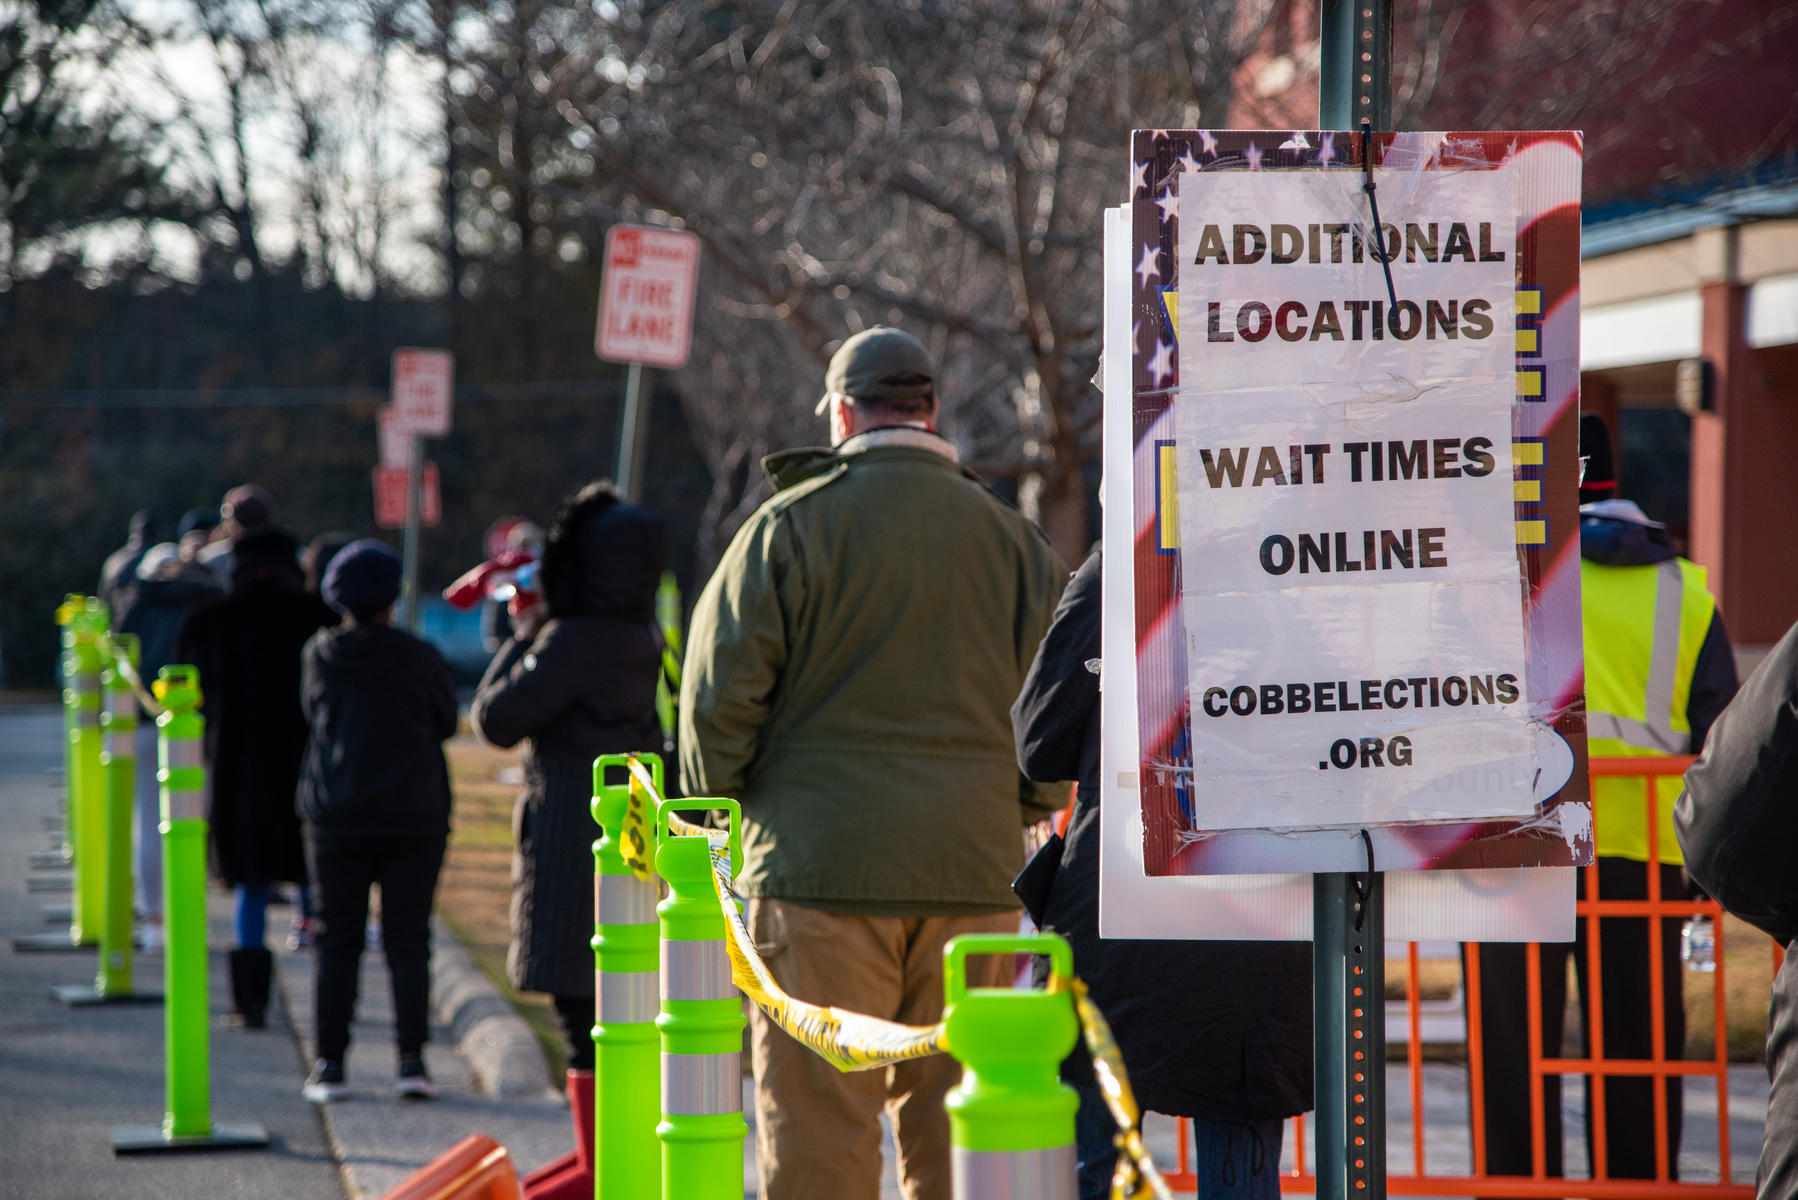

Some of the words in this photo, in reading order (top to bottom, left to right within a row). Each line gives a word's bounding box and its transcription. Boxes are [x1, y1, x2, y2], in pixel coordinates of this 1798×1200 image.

[1194, 222, 1506, 266] ADDITIONAL
[617, 276, 675, 309] FIRE
[610, 310, 675, 343] LANE
[1207, 298, 1494, 343] LOCATIONS
[1199, 443, 1331, 489] WAIT
[1343, 436, 1496, 483] TIMES
[1259, 526, 1448, 576] ONLINE
[1202, 673, 1520, 718] COBBELECTIONS
[1318, 735, 1413, 770] .ORG
